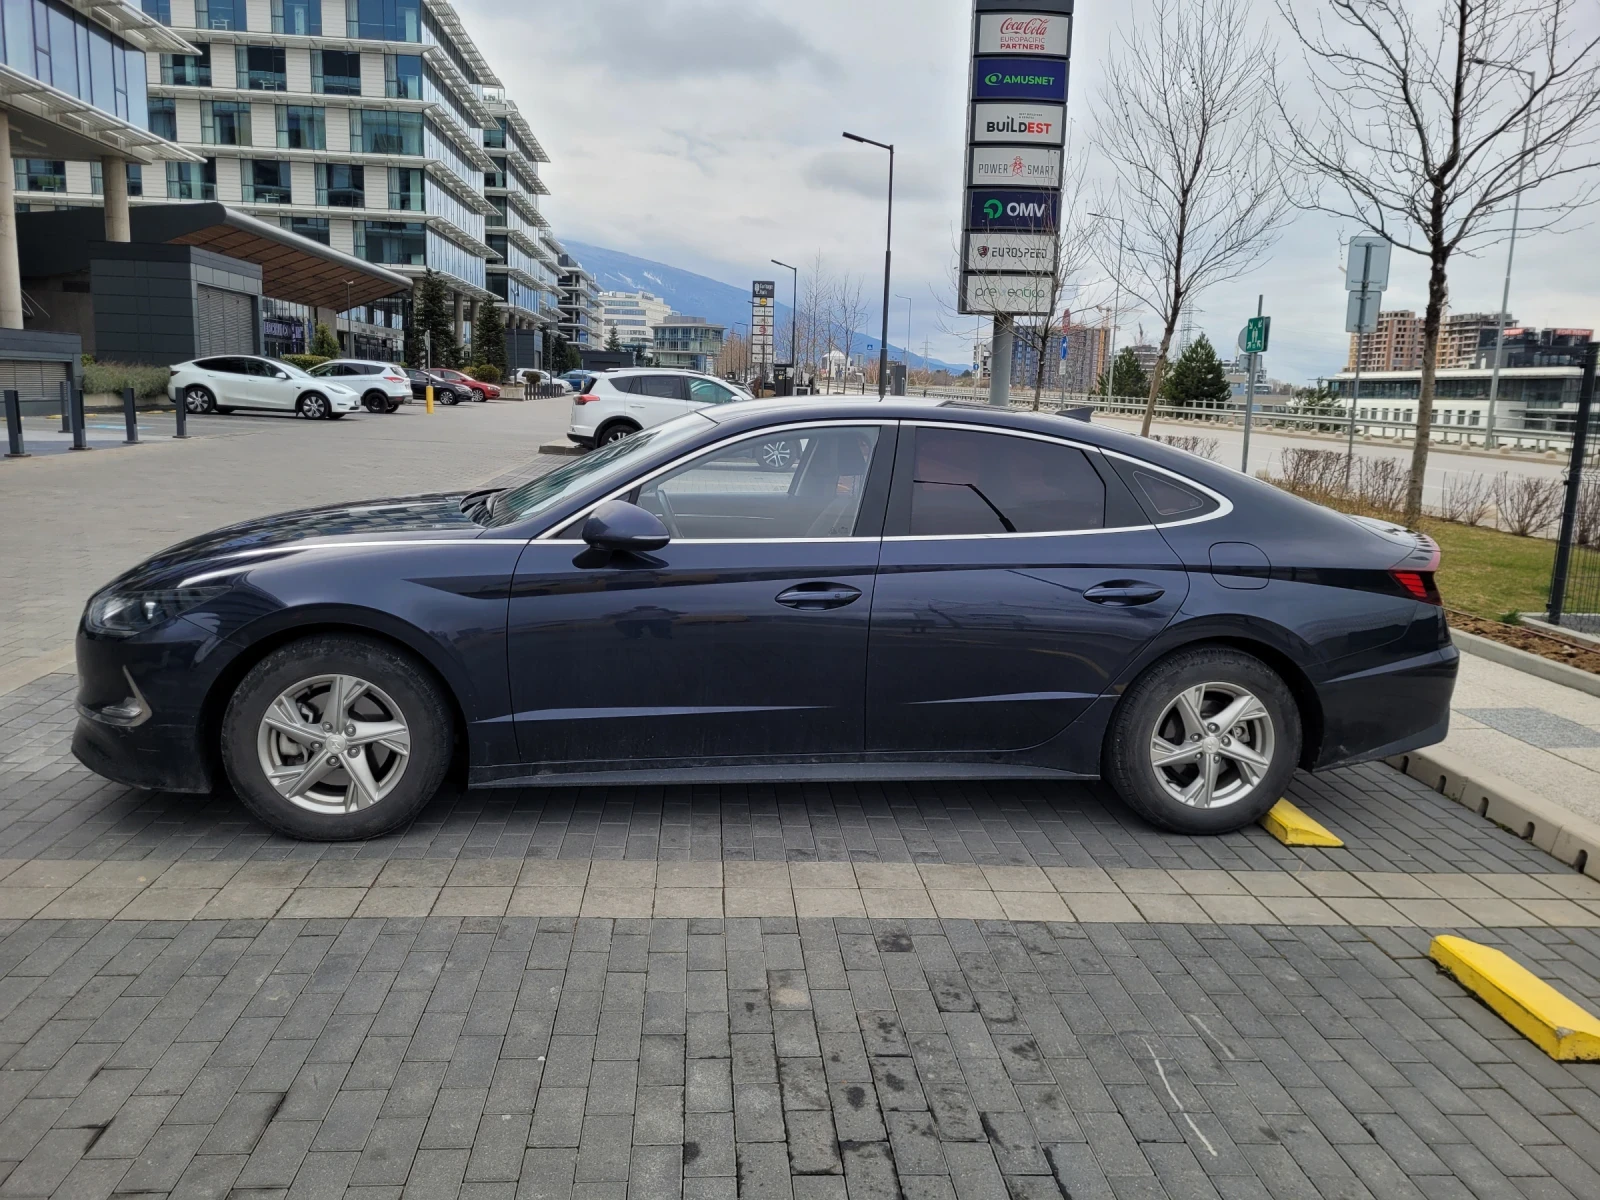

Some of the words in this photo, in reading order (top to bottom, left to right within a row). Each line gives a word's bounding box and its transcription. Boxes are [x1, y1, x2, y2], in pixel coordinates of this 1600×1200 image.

[1003, 75, 1055, 85] AMUSNET
[978, 163, 1008, 174] POWER
[1027, 164, 1054, 176] SMART
[1007, 202, 1045, 217] OMV
[991, 247, 1047, 259] EUROSPEED
